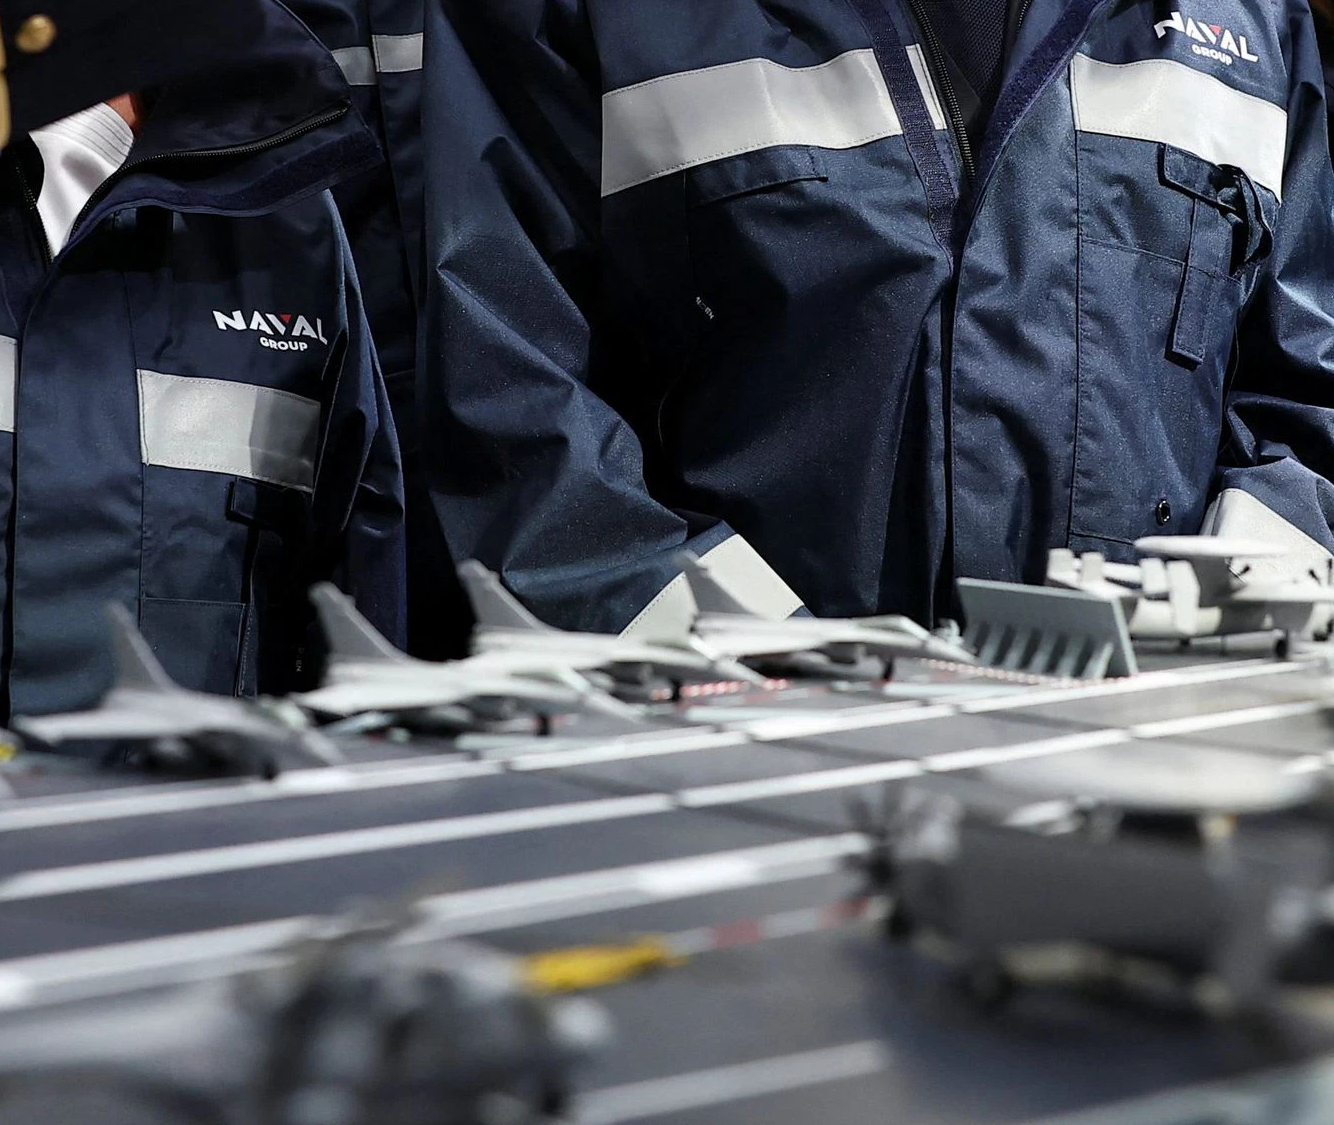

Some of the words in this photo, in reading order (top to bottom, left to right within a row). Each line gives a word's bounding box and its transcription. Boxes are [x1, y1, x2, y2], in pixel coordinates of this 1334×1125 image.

[1154, 11, 1259, 63] NAVAL
[1192, 43, 1233, 66] GROUP
[212, 310, 328, 345] NAVAL
[260, 336, 308, 352] GROUP
